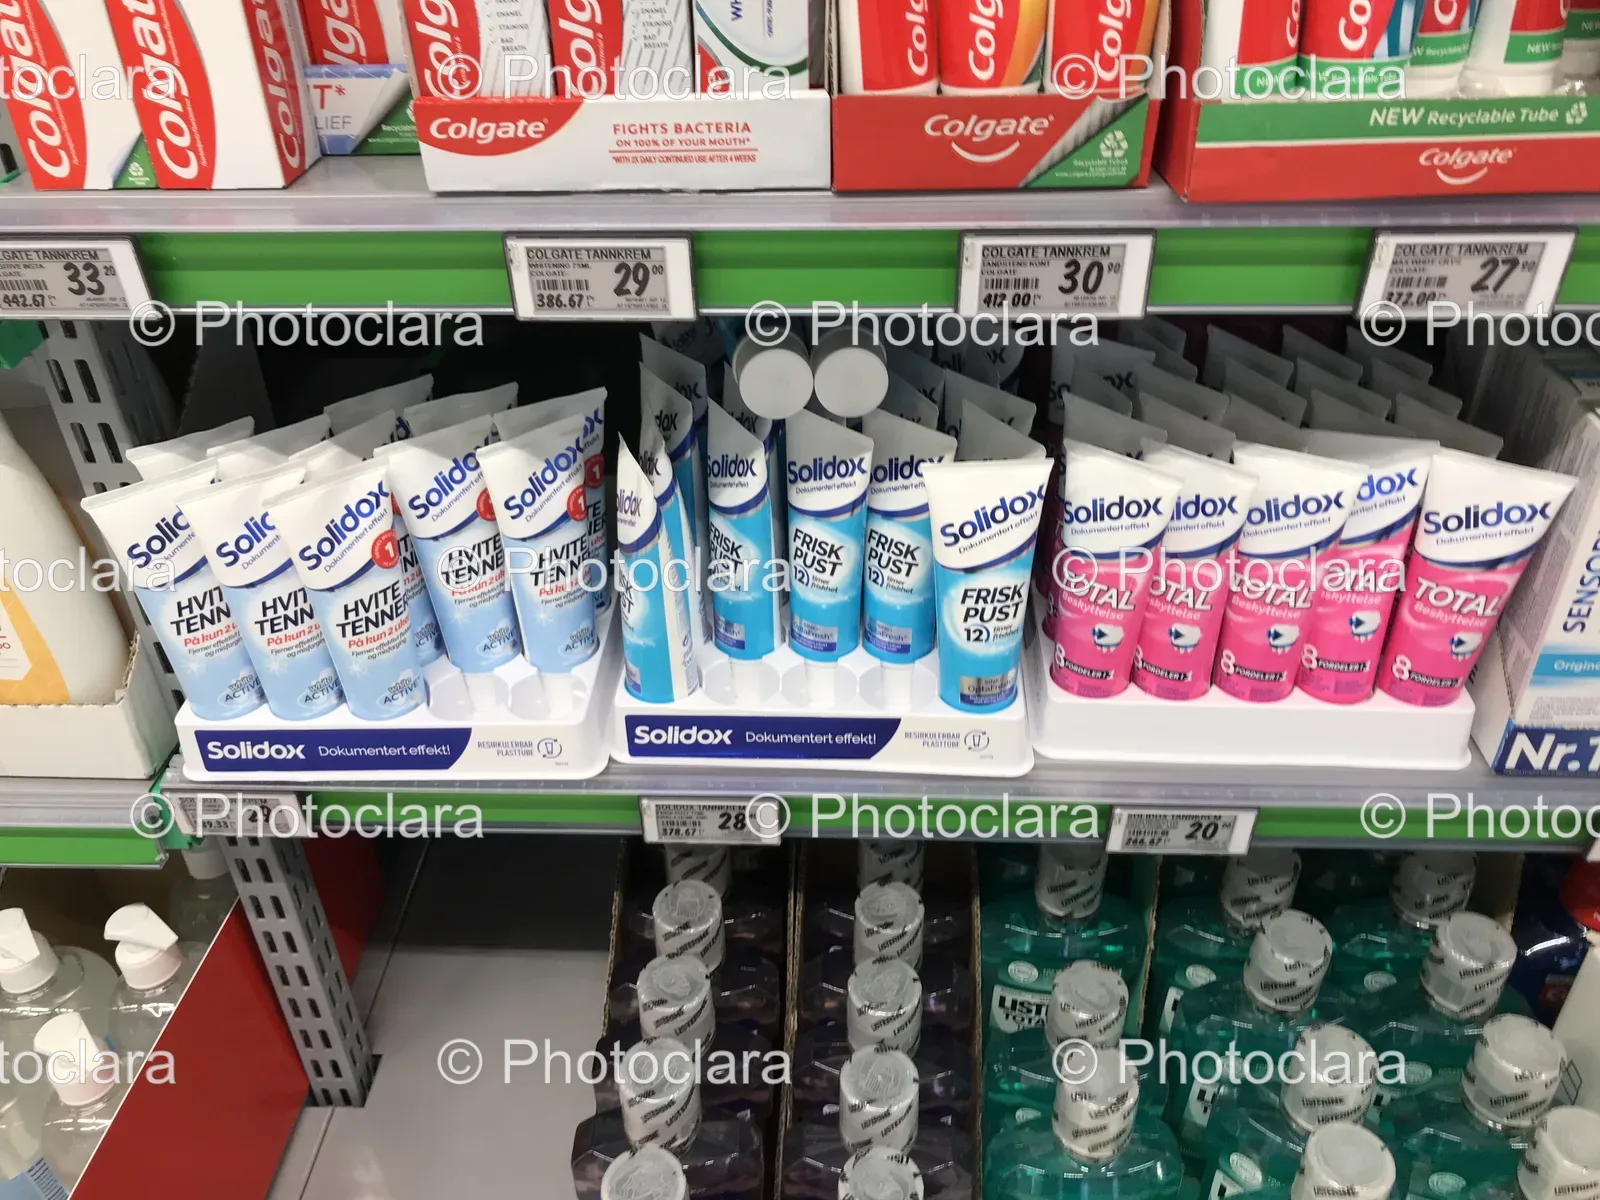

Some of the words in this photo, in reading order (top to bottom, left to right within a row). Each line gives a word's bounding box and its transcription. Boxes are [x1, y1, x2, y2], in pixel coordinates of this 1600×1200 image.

[613, 123, 668, 135] FIGHTS
[674, 122, 751, 134] BACTERIA
[924, 114, 1049, 142] Colgate
[1369, 107, 1425, 126] NEW
[1428, 108, 1516, 129] Recyclable
[1520, 108, 1558, 122] Tube
[430, 117, 546, 144] Colgate
[616, 139, 631, 147] ON
[633, 139, 658, 147] 100%
[677, 138, 707, 147] YOUR
[1419, 147, 1513, 169] Colgate
[0, 251, 33, 260] GATE
[34, 250, 99, 260] TANNKREM
[527, 250, 583, 260] COLGATE
[586, 250, 651, 260] TANNKREM
[982, 246, 1039, 258] COLGATE
[1044, 246, 1110, 258] TANNKREM
[1396, 244, 1454, 256] COLGATE
[1459, 244, 1528, 256] TANNKREM
[63, 261, 105, 295] 33
[103, 265, 116, 276] 20
[613, 261, 650, 297] 29
[652, 264, 664, 275] 00
[1058, 258, 1104, 295] 30
[1107, 262, 1121, 274] 90
[1470, 256, 1520, 293] 27
[3, 294, 45, 307] 442.67
[537, 294, 584, 308] 386.67
[504, 436, 584, 520] Solidox
[788, 454, 867, 485] Solidox
[525, 481, 565, 523] Dokumentert
[564, 463, 583, 486] effekt
[796, 484, 836, 495] Dokumentert
[837, 481, 857, 491] effekt
[871, 483, 914, 495] Dokumentert
[940, 483, 1045, 548] Solidox
[1064, 495, 1163, 524] Solidox
[1424, 502, 1552, 534] Solidox
[299, 480, 391, 571] Solidox
[958, 522, 1015, 555] Dokumentert
[1014, 510, 1038, 532] effekt
[1071, 522, 1122, 535] Dokumentert
[1123, 521, 1150, 530] effekt
[1436, 530, 1501, 546] Dokumentert
[1502, 527, 1534, 539] effekt
[324, 526, 369, 573] Dokumentert
[368, 508, 388, 533] effekt
[793, 528, 845, 561] FRISK
[868, 529, 920, 562] FRISK
[793, 549, 843, 576] PUST
[868, 549, 919, 577] PUST
[344, 578, 400, 620] HVITE
[960, 581, 1026, 605] FRISK
[1414, 576, 1501, 618] TOTAL
[963, 600, 1024, 623] PUST
[202, 627, 224, 643] kun
[284, 627, 307, 643] kun
[348, 637, 365, 649] På
[366, 627, 387, 644] kun
[387, 627, 395, 636] 2
[1220, 649, 1235, 675] 8
[1301, 644, 1318, 670] 8
[1392, 654, 1412, 682] 8
[384, 677, 418, 704] ACTIVE
[477, 741, 534, 750] RESIRKULERBAR
[634, 725, 733, 745] Solidox
[745, 731, 834, 744] Dokumentert
[835, 732, 877, 745] effekt!
[904, 732, 961, 741] RESIRKULERBAR
[922, 740, 961, 748] PLASTTUBE
[208, 741, 306, 759] Solidox
[319, 744, 408, 757] Dokumentert
[409, 744, 452, 757] effekt!
[496, 748, 534, 757] PLASTTUBE
[662, 828, 696, 836] 378.67
[718, 812, 746, 830] 28
[1185, 822, 1219, 841] 20
